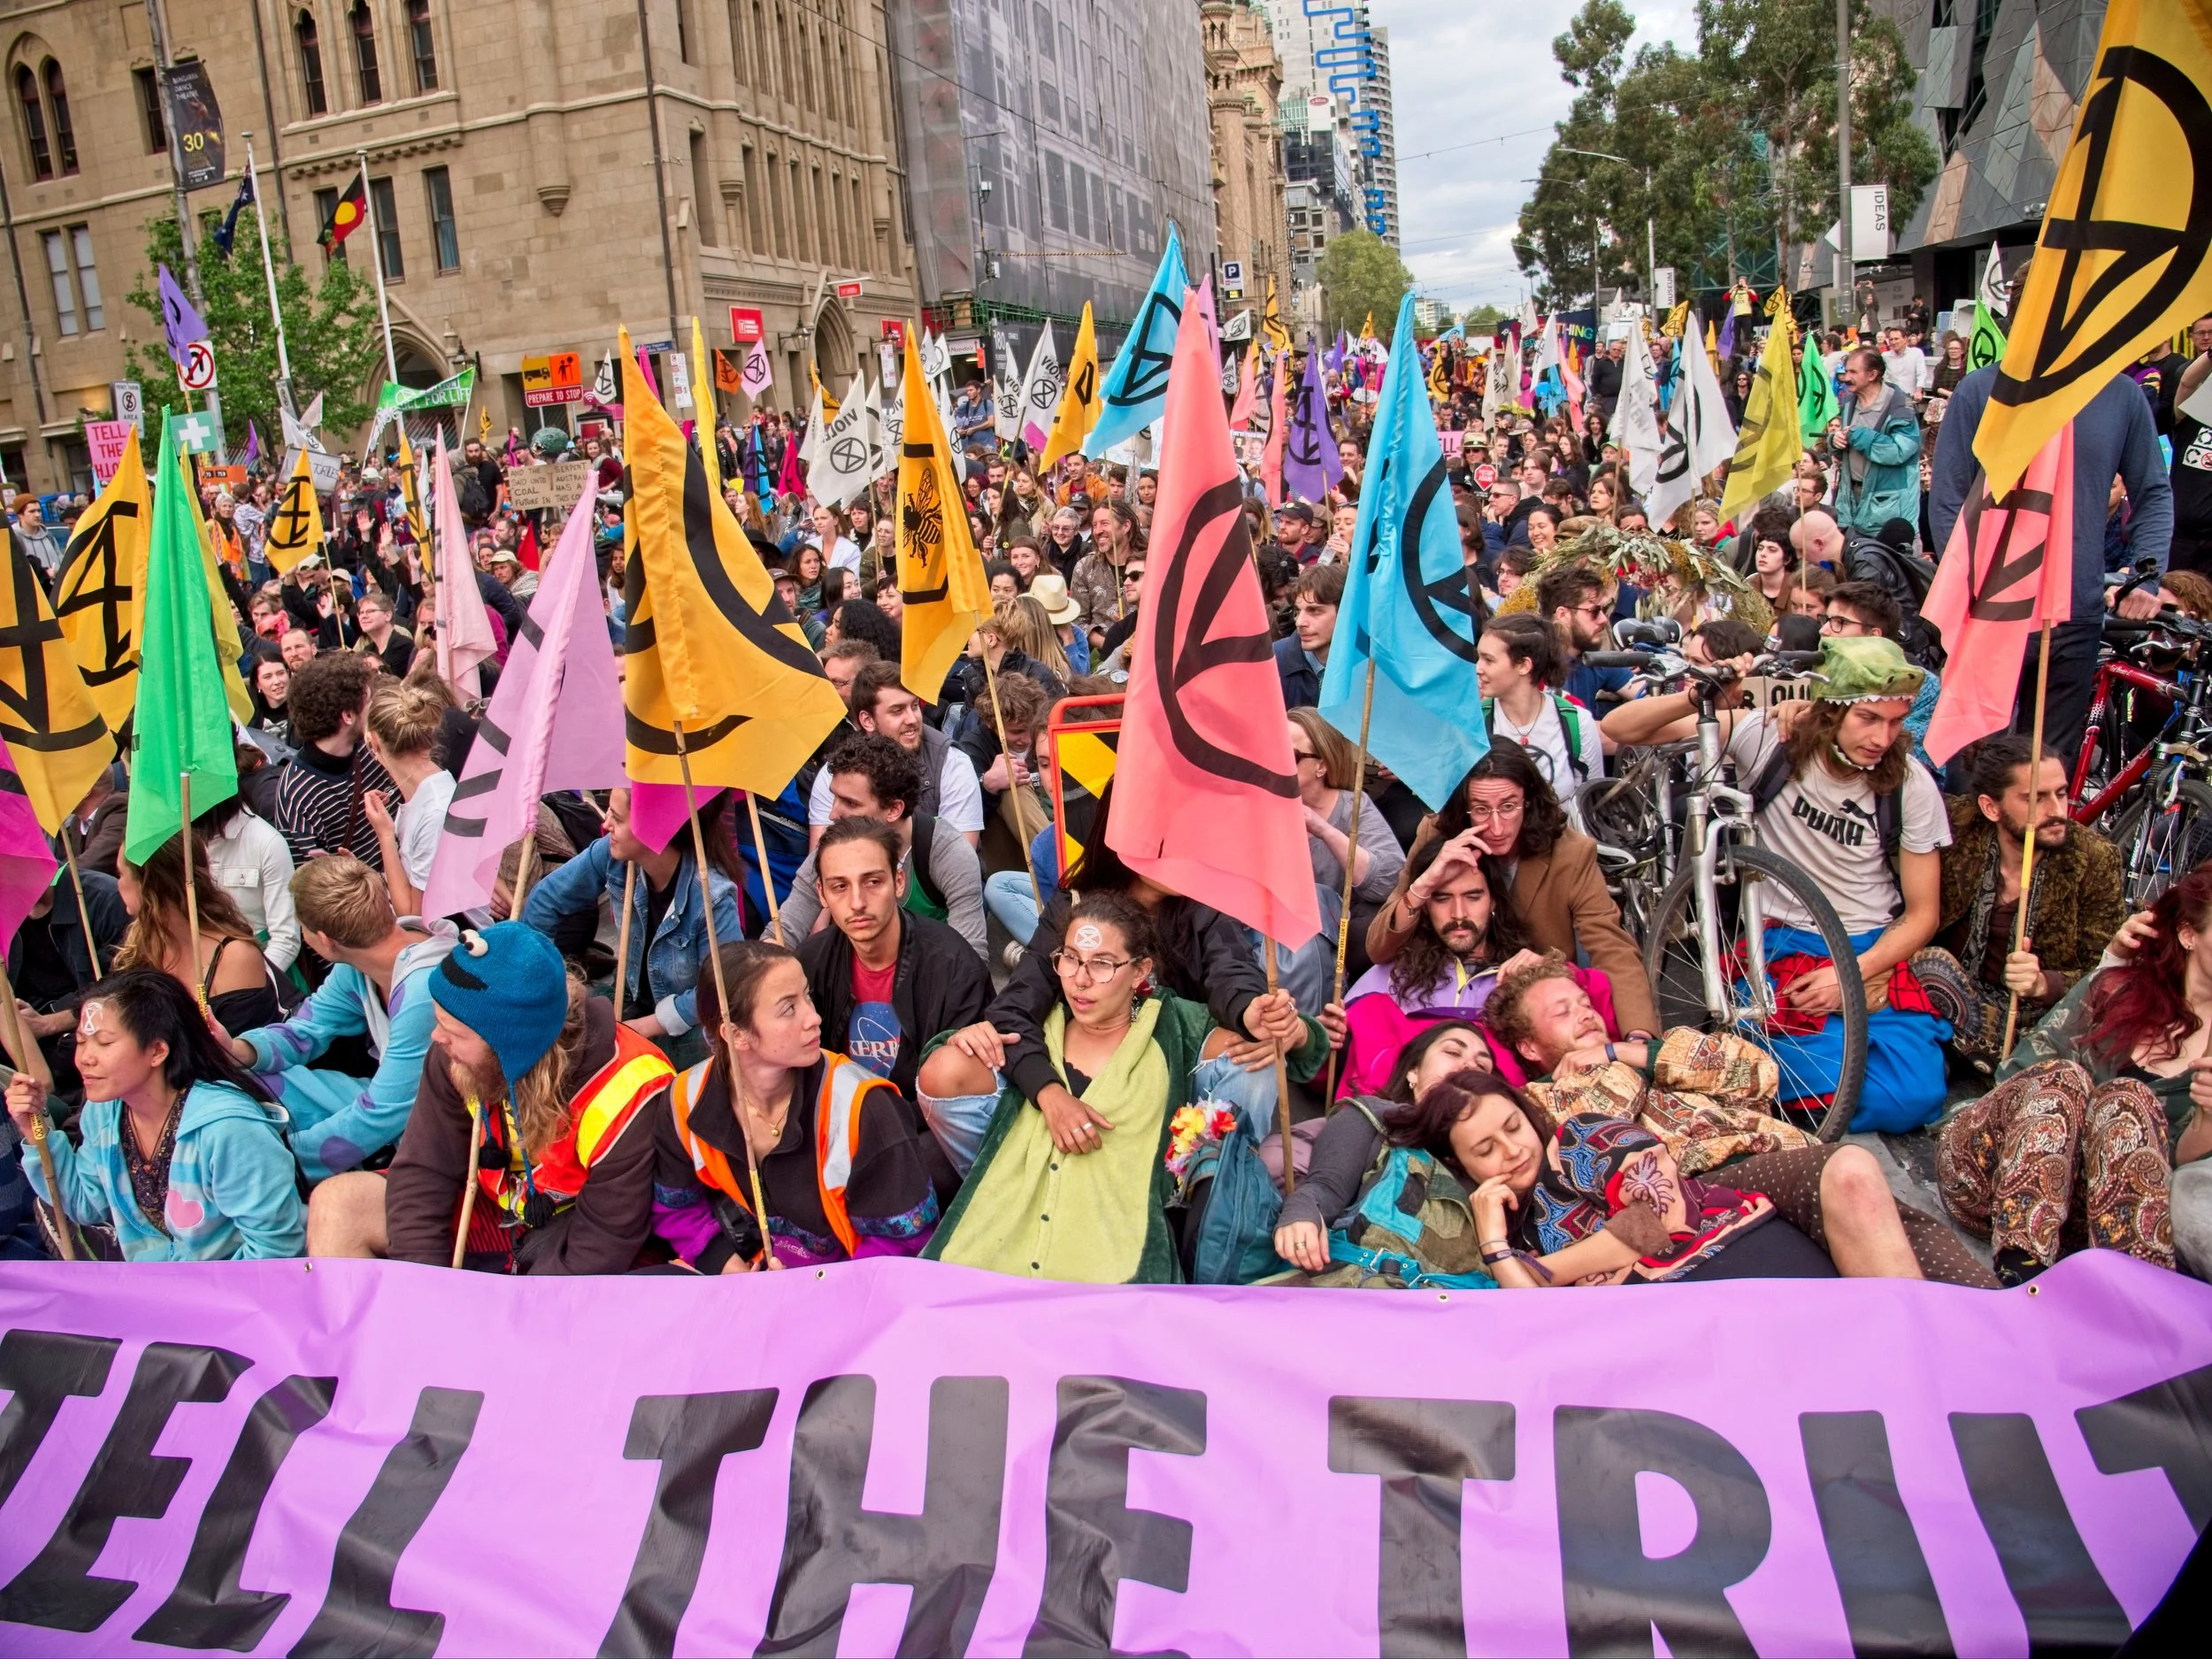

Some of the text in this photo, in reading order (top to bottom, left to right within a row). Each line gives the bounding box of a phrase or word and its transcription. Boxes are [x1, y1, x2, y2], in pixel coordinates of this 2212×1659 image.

[183, 132, 204, 152] 30
[1874, 190, 1886, 232] IDEAS
[1228, 265, 1237, 277] P
[426, 392, 447, 406] FOR
[527, 389, 581, 404] PREPARE TO STOP
[91, 424, 127, 442] TELL
[97, 442, 123, 458] THE
[554, 462, 588, 473] SERPENT
[511, 478, 527, 487] SAID
[515, 497, 539, 506] FUTURE
[542, 496, 551, 505] IN
[1791, 795, 1865, 847] PUMA
[596, 1373, 1208, 1659] THE
